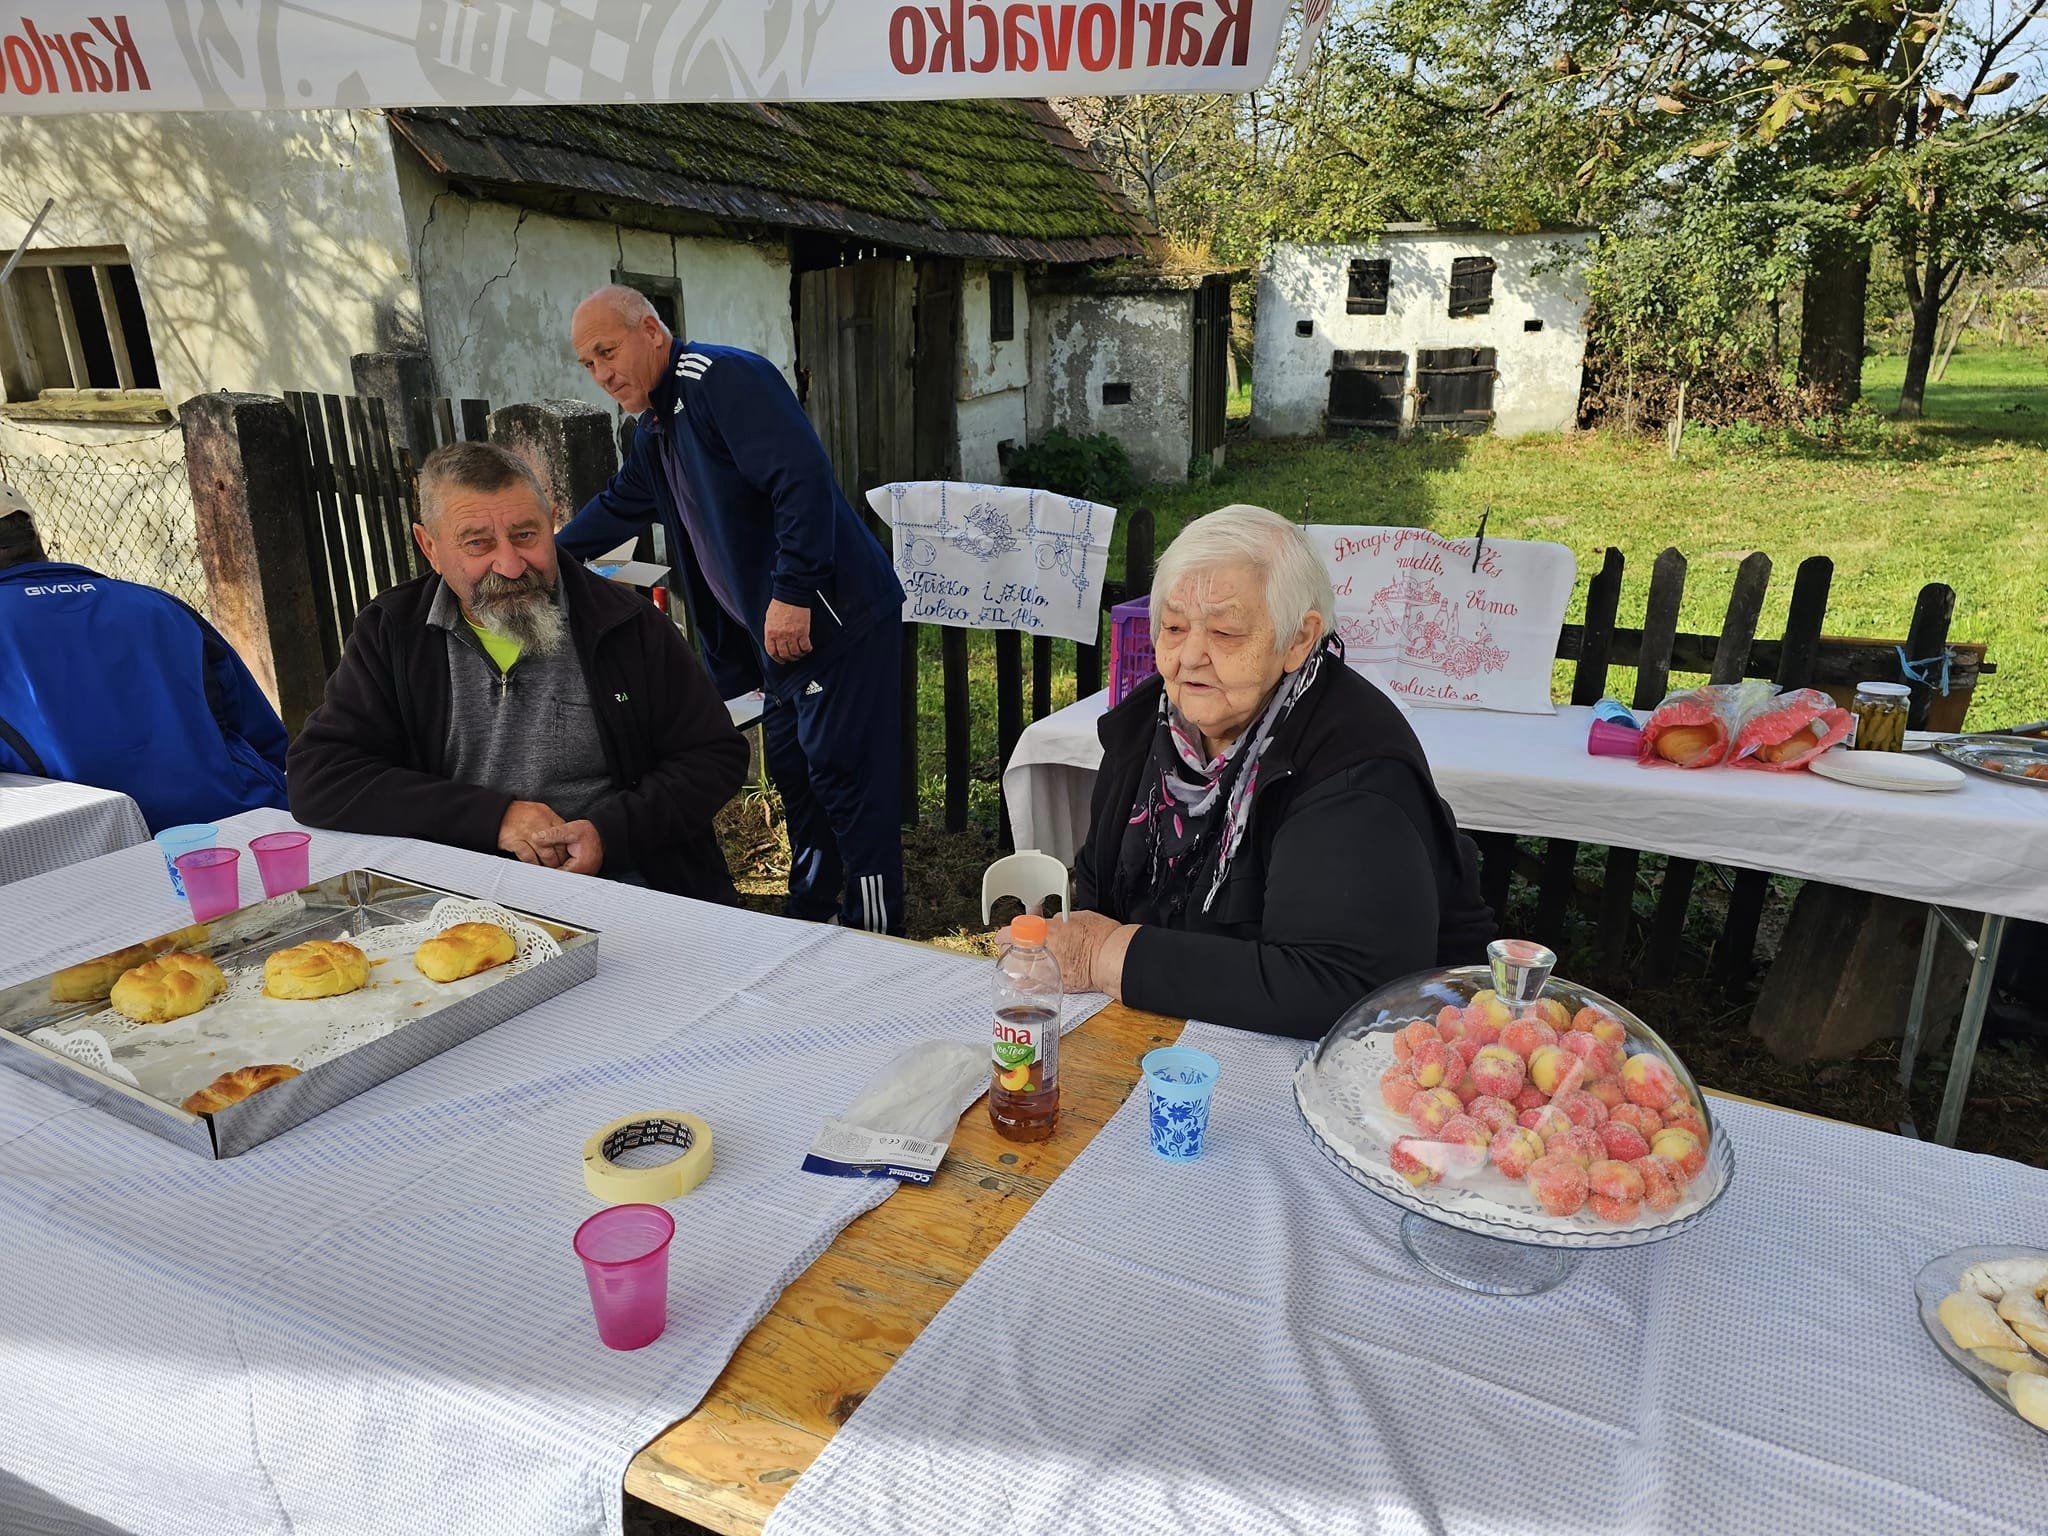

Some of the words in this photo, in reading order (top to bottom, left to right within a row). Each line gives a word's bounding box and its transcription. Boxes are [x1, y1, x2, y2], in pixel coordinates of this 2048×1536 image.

[1334, 530, 1391, 562] Dragi
[24, 583, 97, 596] GIVOVA
[982, 581, 994, 601] i
[911, 597, 969, 620] dobro
[1465, 589, 1518, 616] Vama
